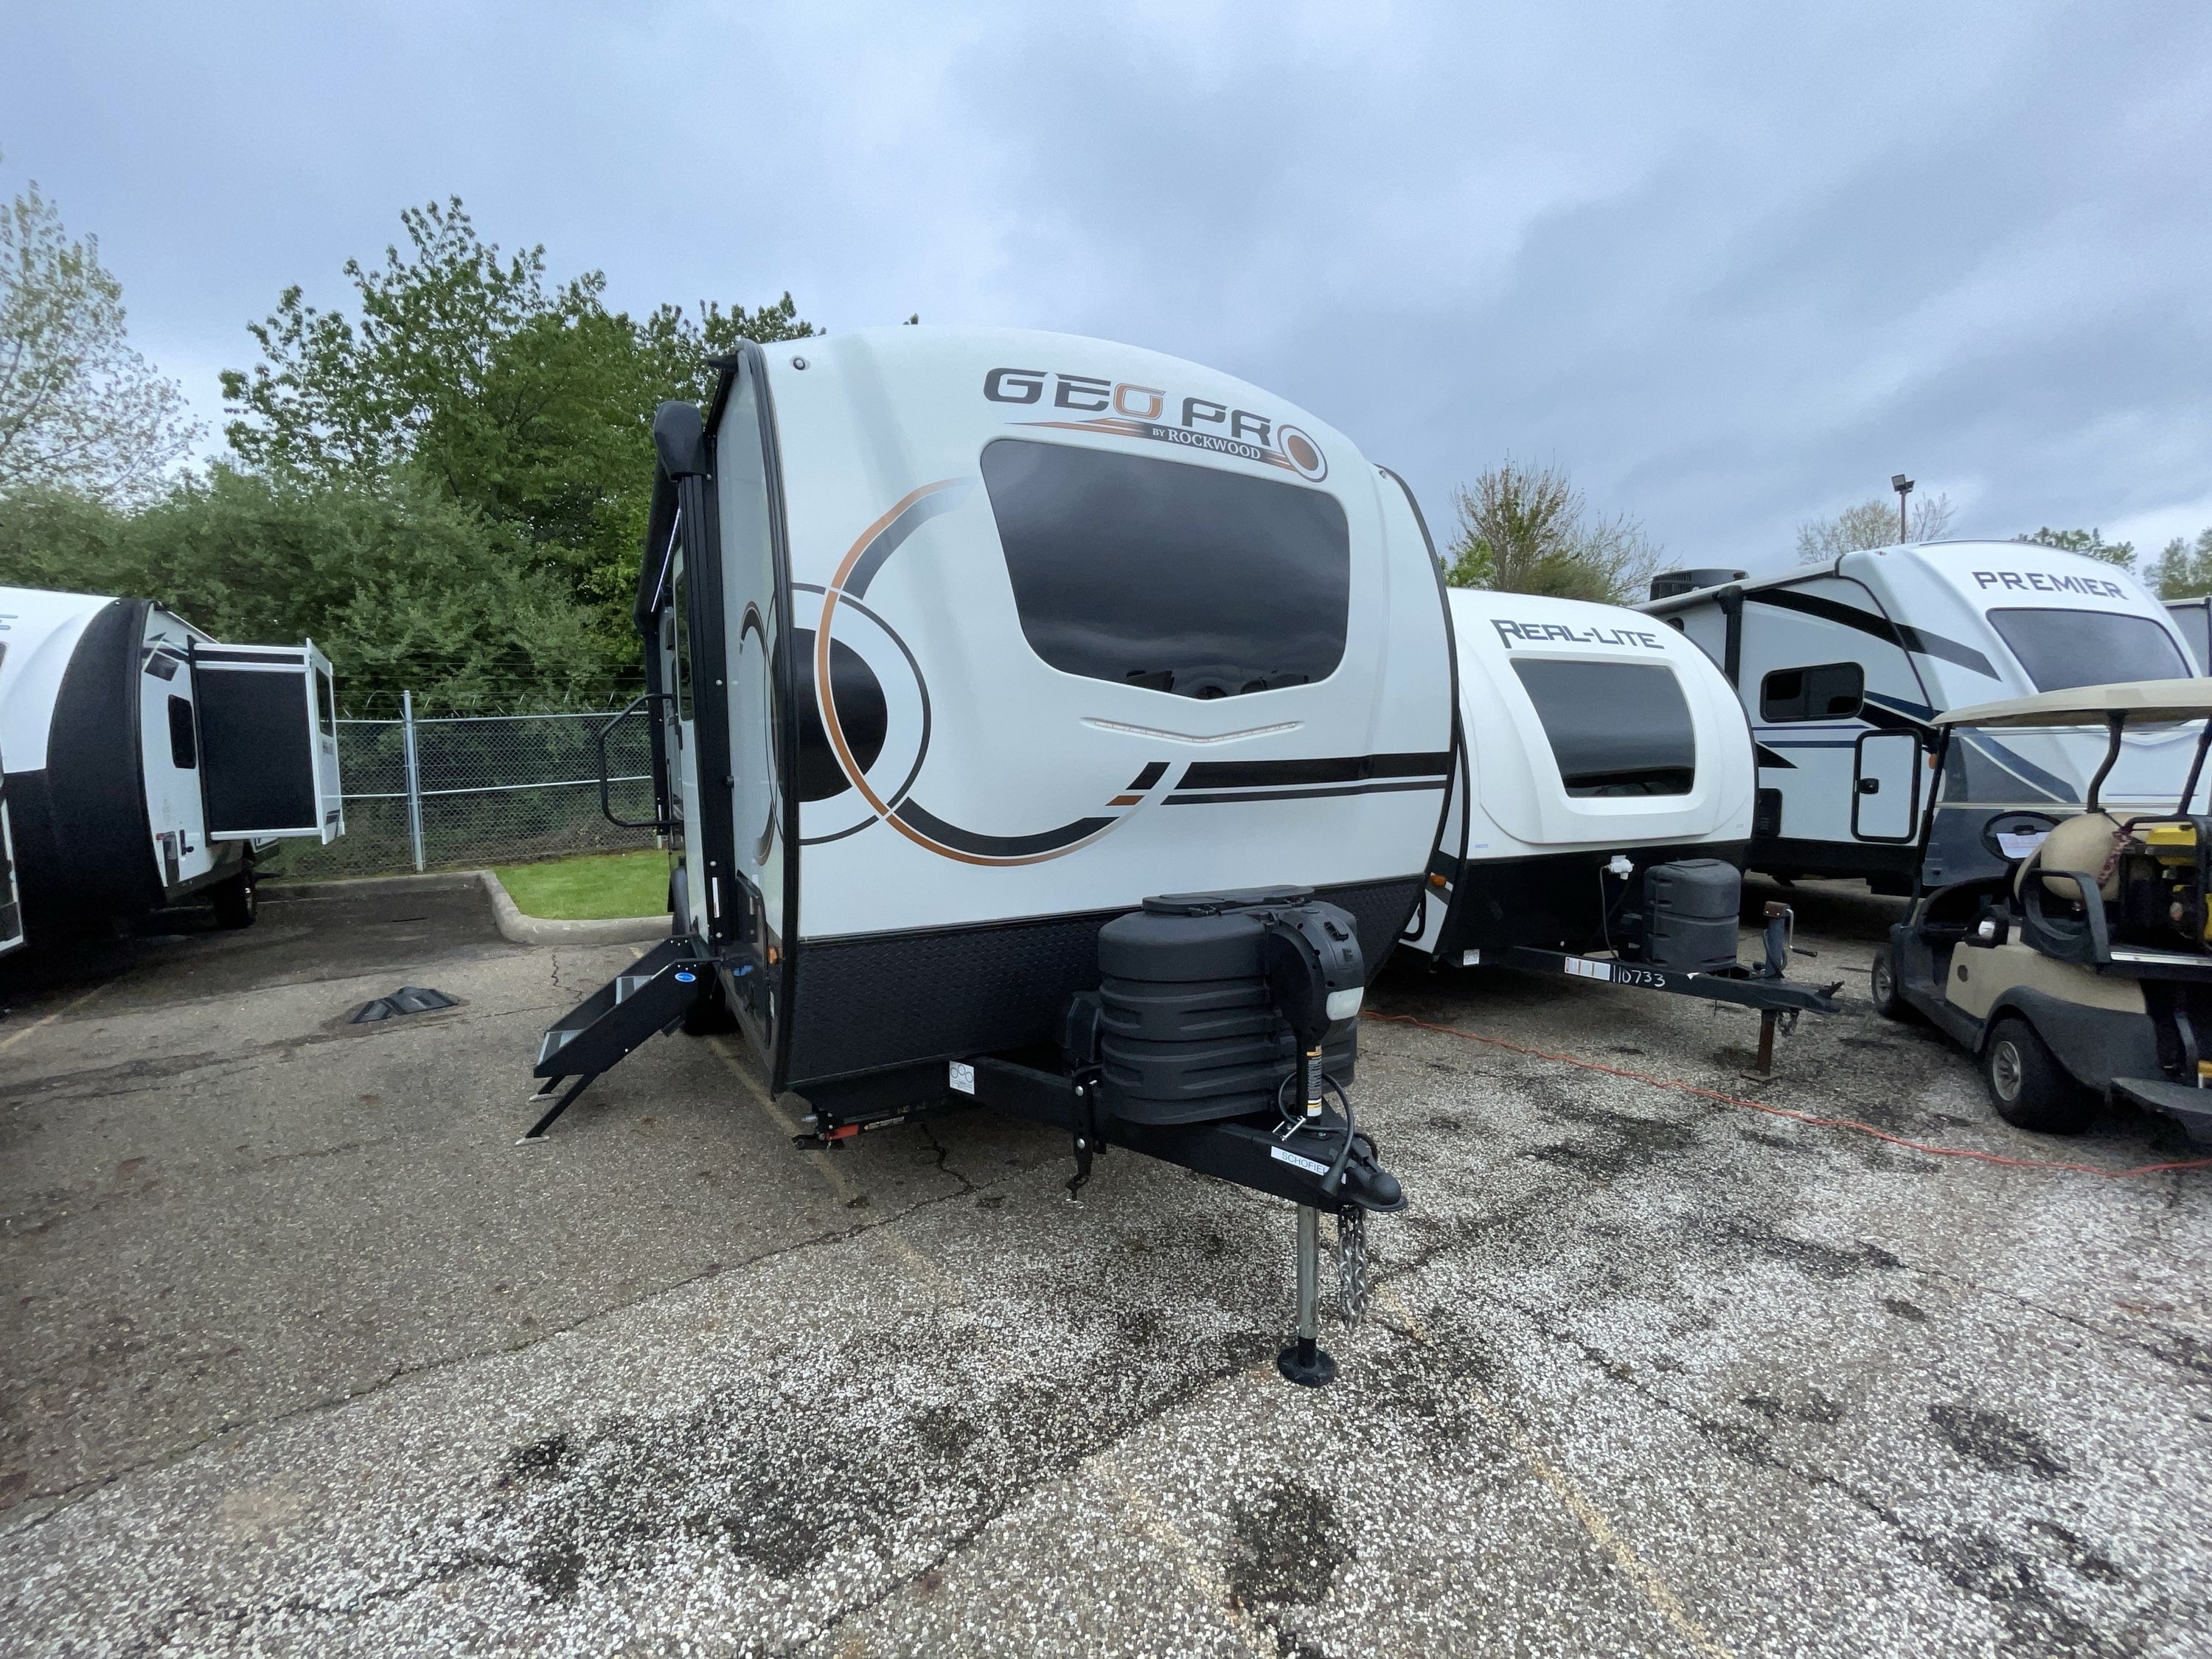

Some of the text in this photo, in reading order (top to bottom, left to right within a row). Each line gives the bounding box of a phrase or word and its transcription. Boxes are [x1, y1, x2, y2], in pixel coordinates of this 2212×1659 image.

[984, 368, 1166, 420] GEO
[1152, 428, 1261, 459] BY ROCKWOOD
[1972, 571, 2129, 600] PREMIER
[1490, 619, 1664, 649] REAL-LITE
[1281, 1152, 1326, 1174] SCHOFIEL
